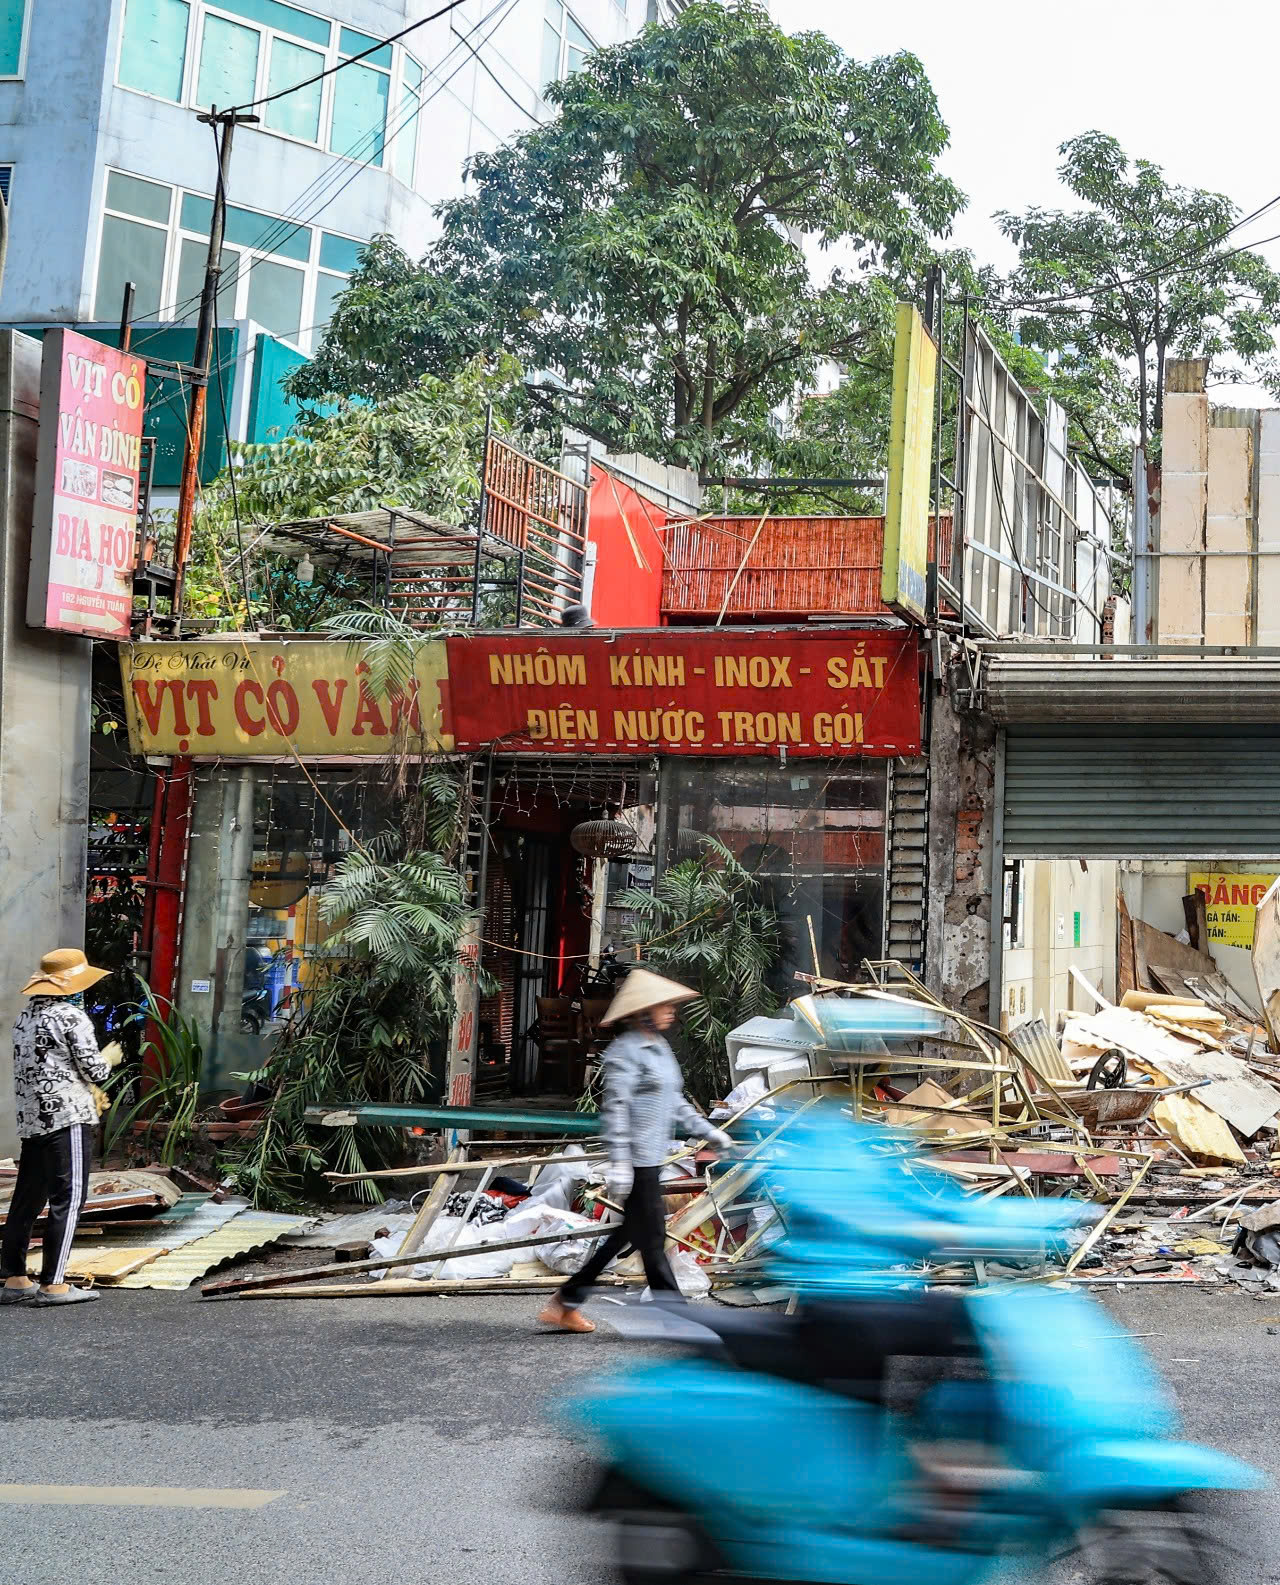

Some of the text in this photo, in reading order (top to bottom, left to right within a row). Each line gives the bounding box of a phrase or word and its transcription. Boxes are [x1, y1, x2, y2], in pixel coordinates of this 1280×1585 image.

[67, 352, 141, 410] VỊT CỎ
[60, 406, 98, 457] VÂN
[56, 513, 92, 562] BIA
[488, 647, 587, 686] NHÔM
[609, 648, 686, 687] KÍNH
[714, 656, 793, 687] INOX
[827, 641, 888, 689] SẮT
[132, 679, 218, 752] VỊT
[234, 655, 299, 736] CỎ
[311, 660, 422, 736] VÂN
[613, 701, 704, 742] NƯỚC
[812, 703, 864, 744] GÓI
[1197, 877, 1267, 906] BẢNG
